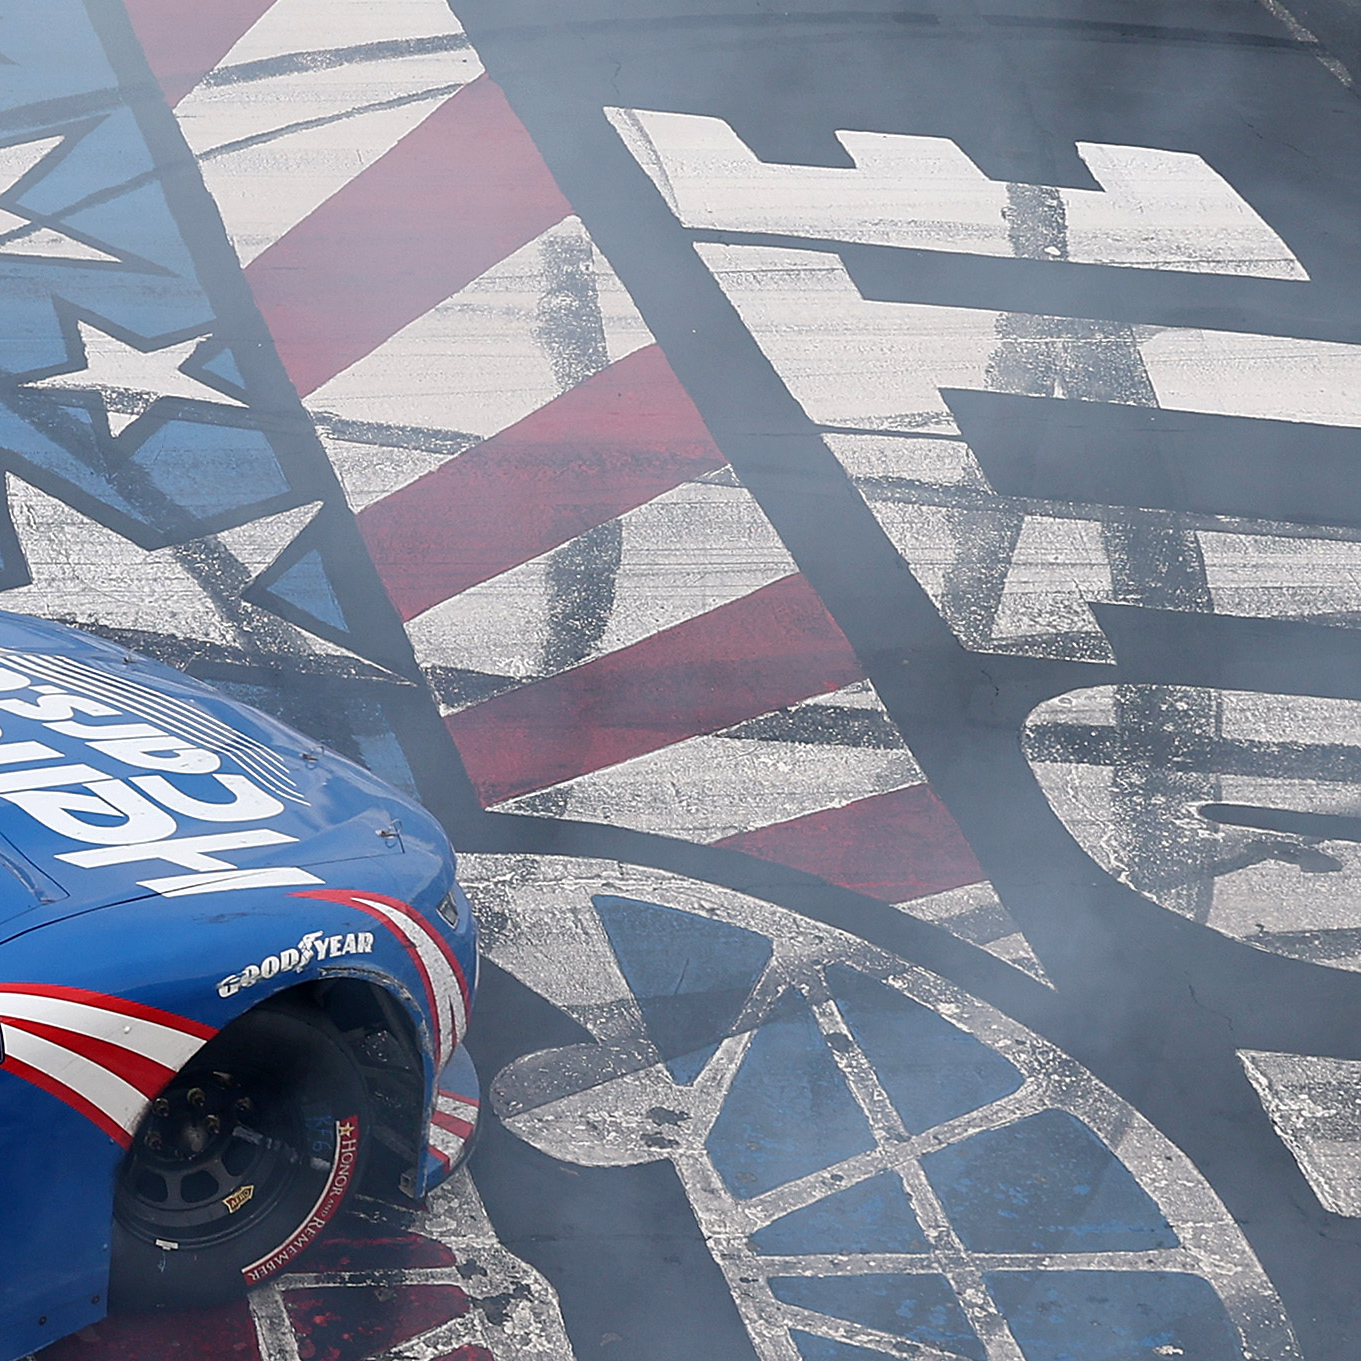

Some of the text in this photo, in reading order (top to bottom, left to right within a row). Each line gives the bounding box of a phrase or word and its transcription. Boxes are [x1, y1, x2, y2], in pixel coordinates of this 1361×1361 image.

[216, 930, 375, 998] GOODYEAR
[329, 1138, 357, 1196] HONOR
[248, 1217, 326, 1282] REMEMBER
